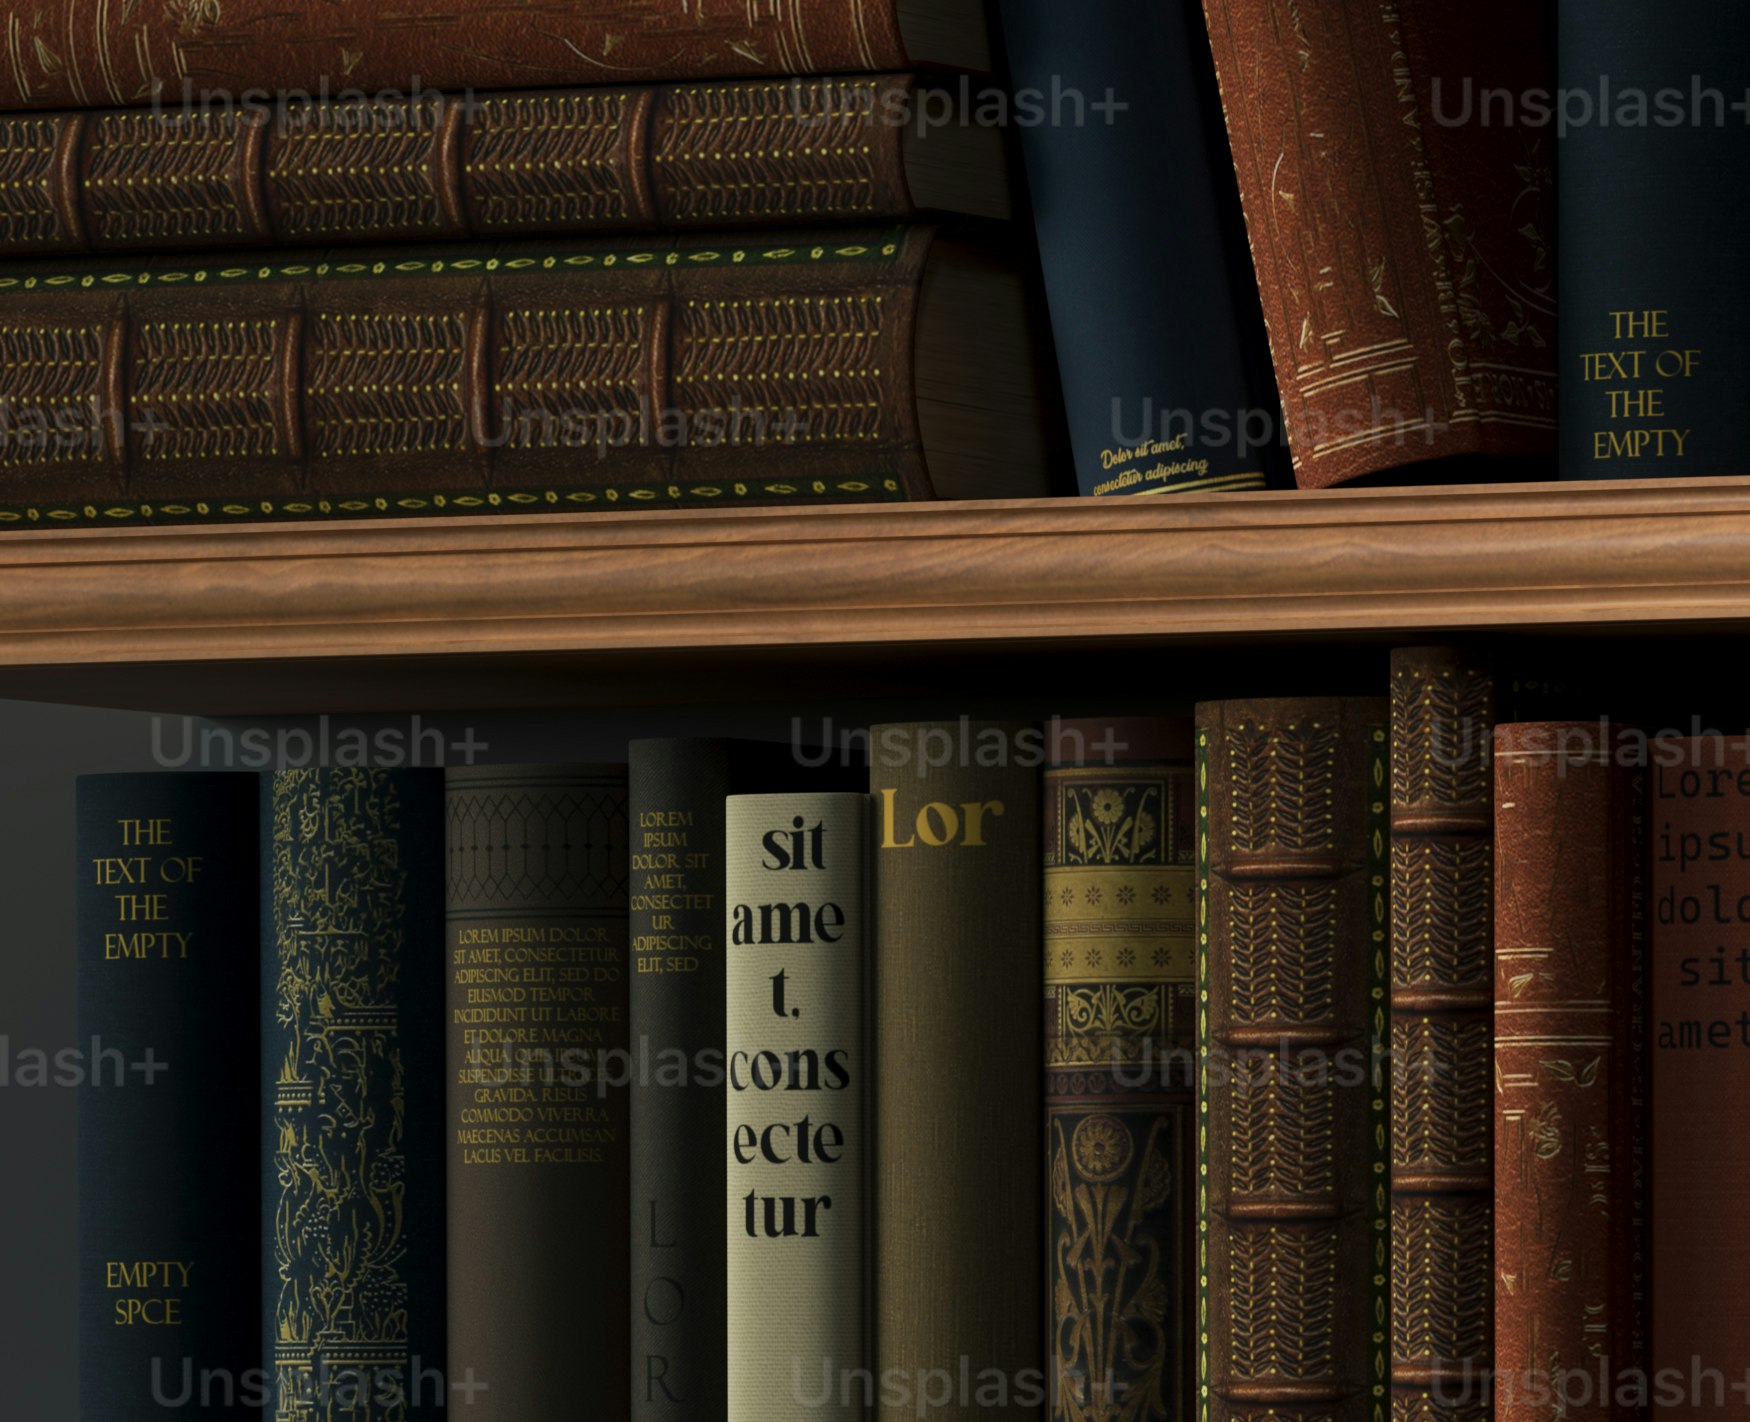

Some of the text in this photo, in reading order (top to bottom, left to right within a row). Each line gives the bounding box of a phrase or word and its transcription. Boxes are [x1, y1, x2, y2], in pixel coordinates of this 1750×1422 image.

[1610, 308, 1672, 340] THE
[1581, 348, 1699, 382] TEXT OF
[1602, 388, 1667, 420] THE
[1100, 447, 1134, 470] Dolor
[1134, 439, 1155, 458] sit
[1593, 428, 1690, 461] EMPTY
[1144, 458, 1209, 484] adipiscing
[117, 817, 173, 849] THE
[639, 811, 694, 828] LOREM
[880, 787, 1007, 849] Lor
[642, 832, 689, 848] IPSUM
[762, 814, 828, 871] sit
[93, 855, 203, 886] TEXT OF
[632, 853, 711, 870] DOLOR SIT
[112, 892, 169, 924] THE
[630, 894, 714, 911] CONSECTET
[651, 914, 676, 931] UR
[732, 894, 845, 946] ame
[105, 929, 192, 961] EMPTY
[459, 928, 609, 945] LOREM IPSUM DOLOR
[631, 935, 714, 952] ADIPISCING
[504, 948, 619, 963] CONSECTETUR
[730, 1042, 851, 1094] cons
[733, 1116, 845, 1168] ecte
[743, 1187, 831, 1240] tur
[106, 1259, 191, 1290] EMPTY
[114, 1296, 183, 1326] SPCE
